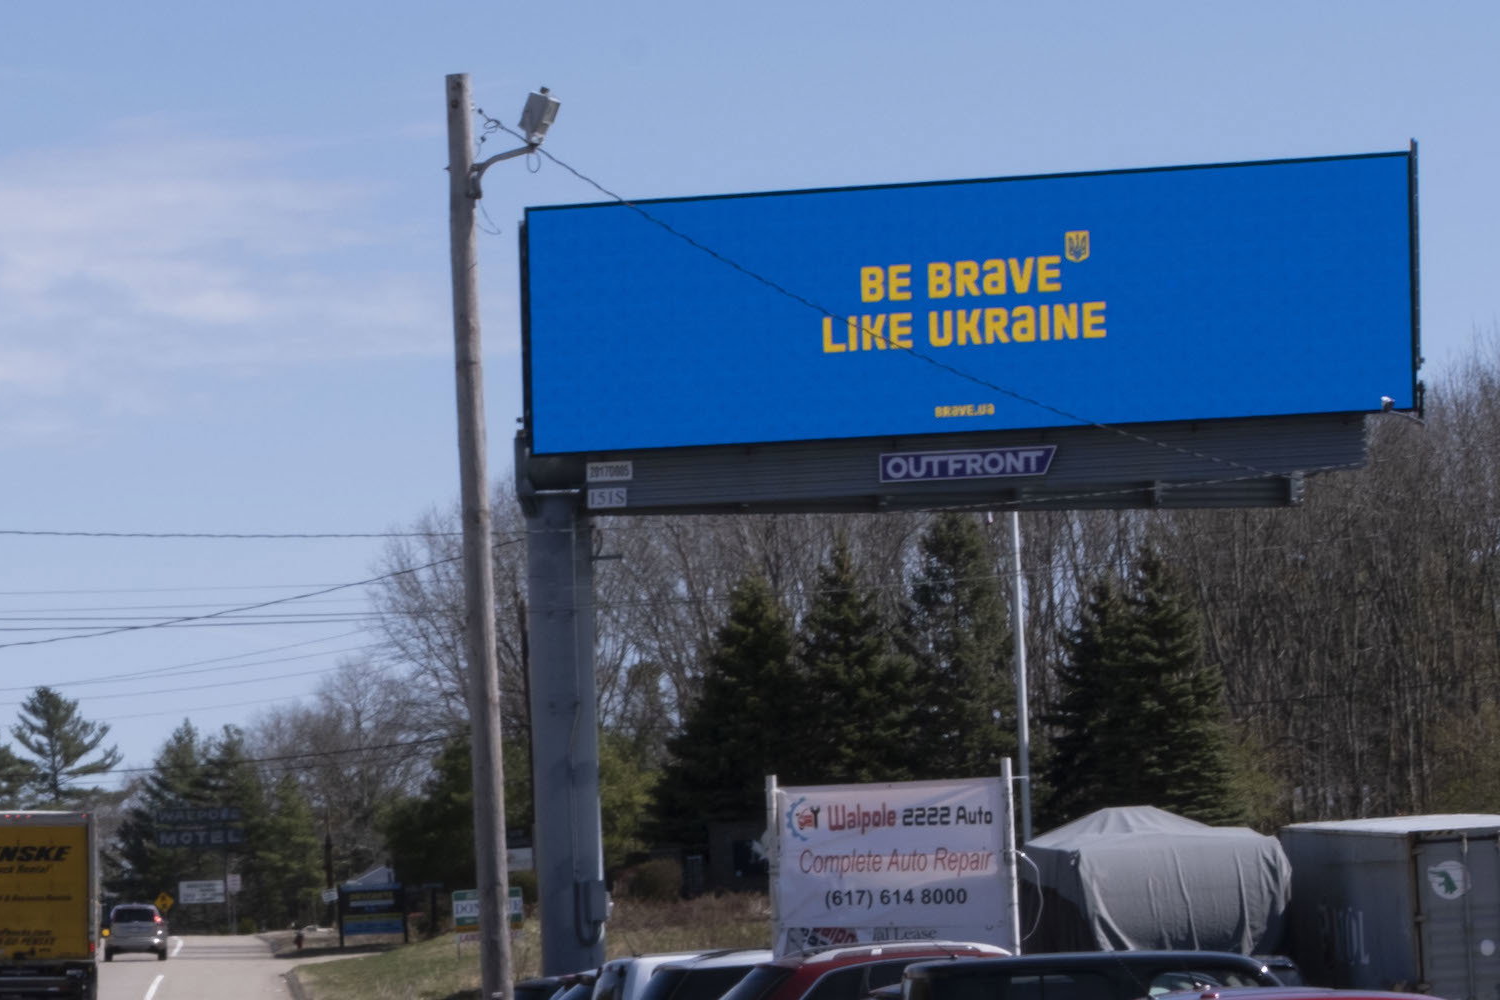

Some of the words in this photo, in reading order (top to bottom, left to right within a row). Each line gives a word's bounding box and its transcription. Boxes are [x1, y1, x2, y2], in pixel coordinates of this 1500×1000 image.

[860, 264, 912, 302] BE
[822, 312, 913, 353] LIKE
[885, 450, 1045, 478] OUTFRONT
[827, 803, 896, 834] Walpole
[902, 806, 950, 826] 2222
[955, 806, 993, 825] Auto
[159, 830, 241, 845] MOTEL
[800, 848, 882, 878] Complete
[887, 850, 928, 872] Auto
[933, 846, 992, 876] Repair
[825, 889, 873, 909] (617)
[879, 889, 914, 905] 614
[921, 888, 968, 904] 8000
